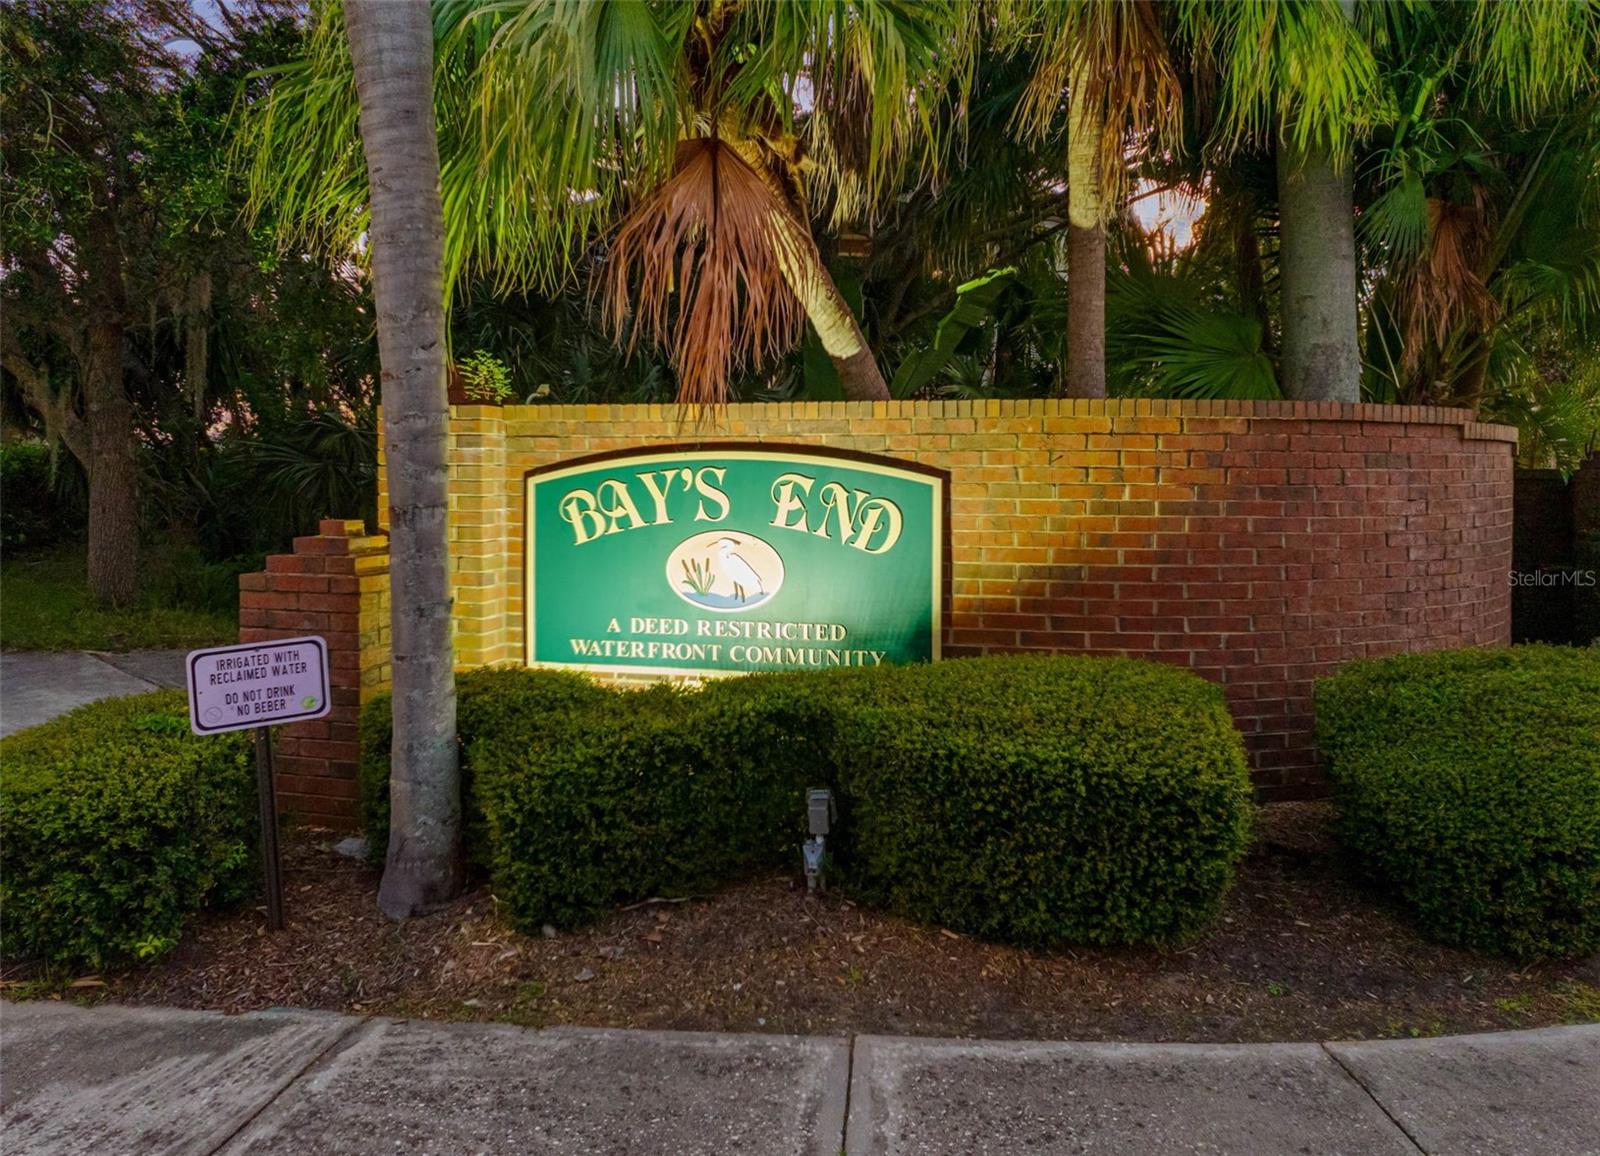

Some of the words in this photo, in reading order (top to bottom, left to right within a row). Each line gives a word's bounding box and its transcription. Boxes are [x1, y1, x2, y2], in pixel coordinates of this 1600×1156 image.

[559, 466, 730, 546] BAY'S
[770, 472, 905, 555] END
[607, 618, 621, 634] A
[630, 617, 689, 636] DEED
[696, 620, 847, 641] RESTRICTED
[216, 653, 270, 671] IRRIGATED
[273, 650, 300, 663] WITH
[570, 638, 722, 662] WATERFRONT
[730, 645, 887, 667] COMMUNITY
[209, 667, 267, 686] RECLAIMED
[271, 662, 307, 676] WATER
[225, 693, 239, 705] DO
[242, 689, 262, 702] NOT
[266, 684, 296, 699] DRINK
[236, 704, 250, 716] NO
[254, 699, 287, 714] BEBER
